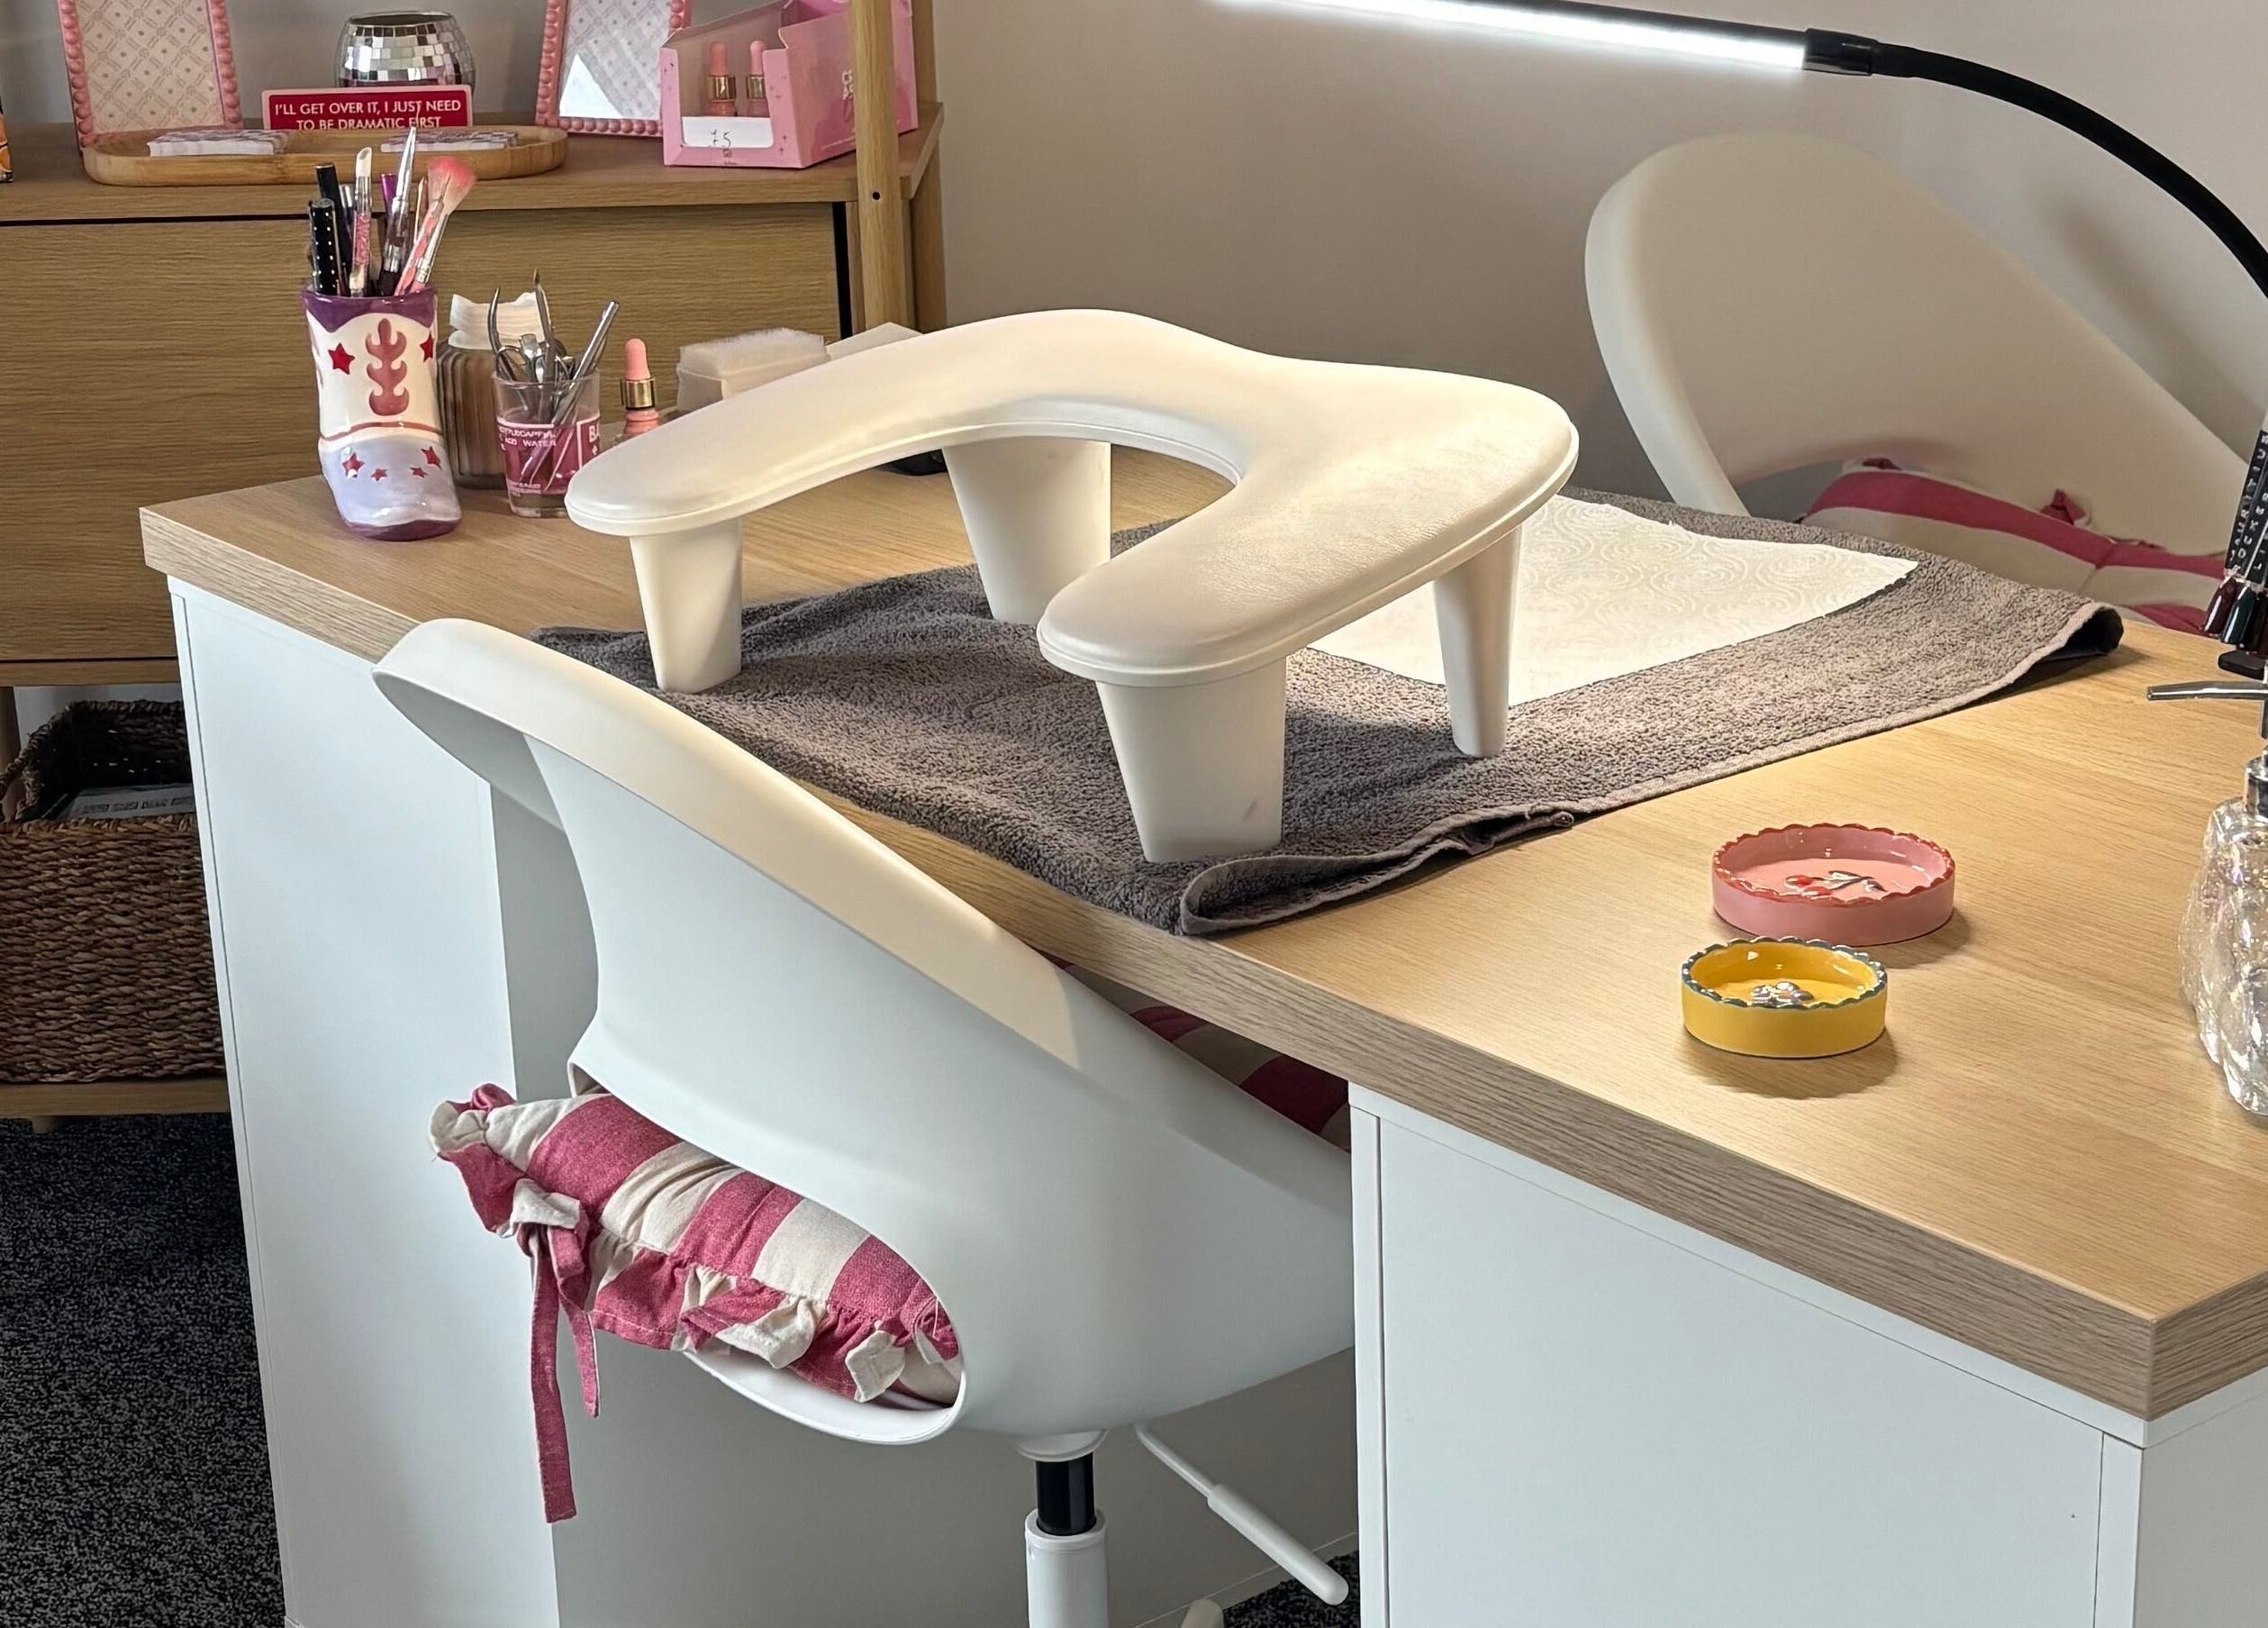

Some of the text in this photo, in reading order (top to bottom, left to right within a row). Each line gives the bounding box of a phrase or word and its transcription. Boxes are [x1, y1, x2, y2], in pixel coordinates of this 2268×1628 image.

[275, 99, 461, 115] I'LL GET OVER IT, I JUST NEED
[295, 116, 441, 130] TO BE DRAMATIC FIRST
